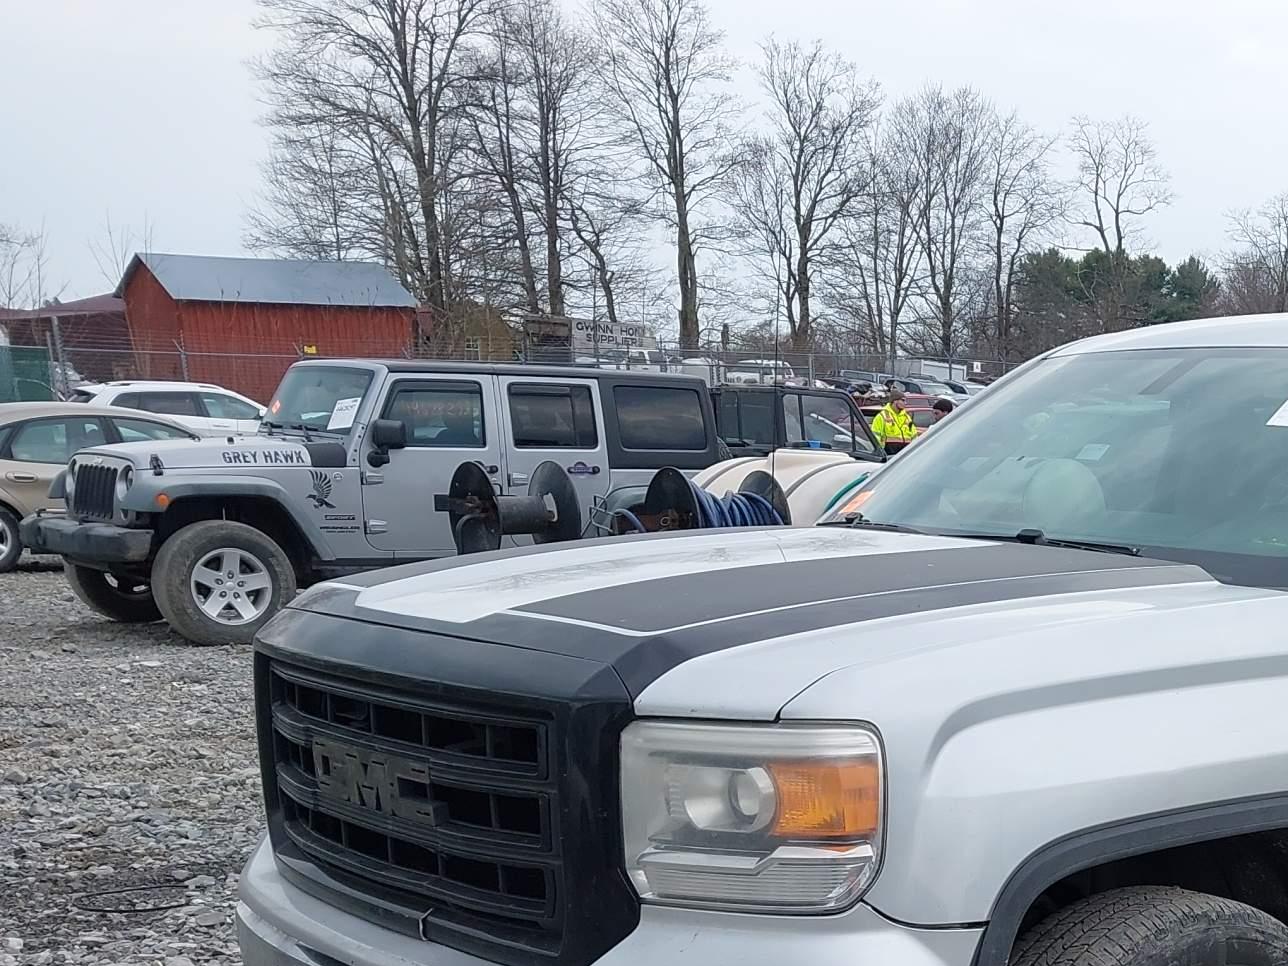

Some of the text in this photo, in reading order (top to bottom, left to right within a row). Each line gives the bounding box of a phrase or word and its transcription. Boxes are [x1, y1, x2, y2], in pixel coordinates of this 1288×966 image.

[222, 450, 305, 464] GREY HAWK
[312, 738, 436, 828] GMC
